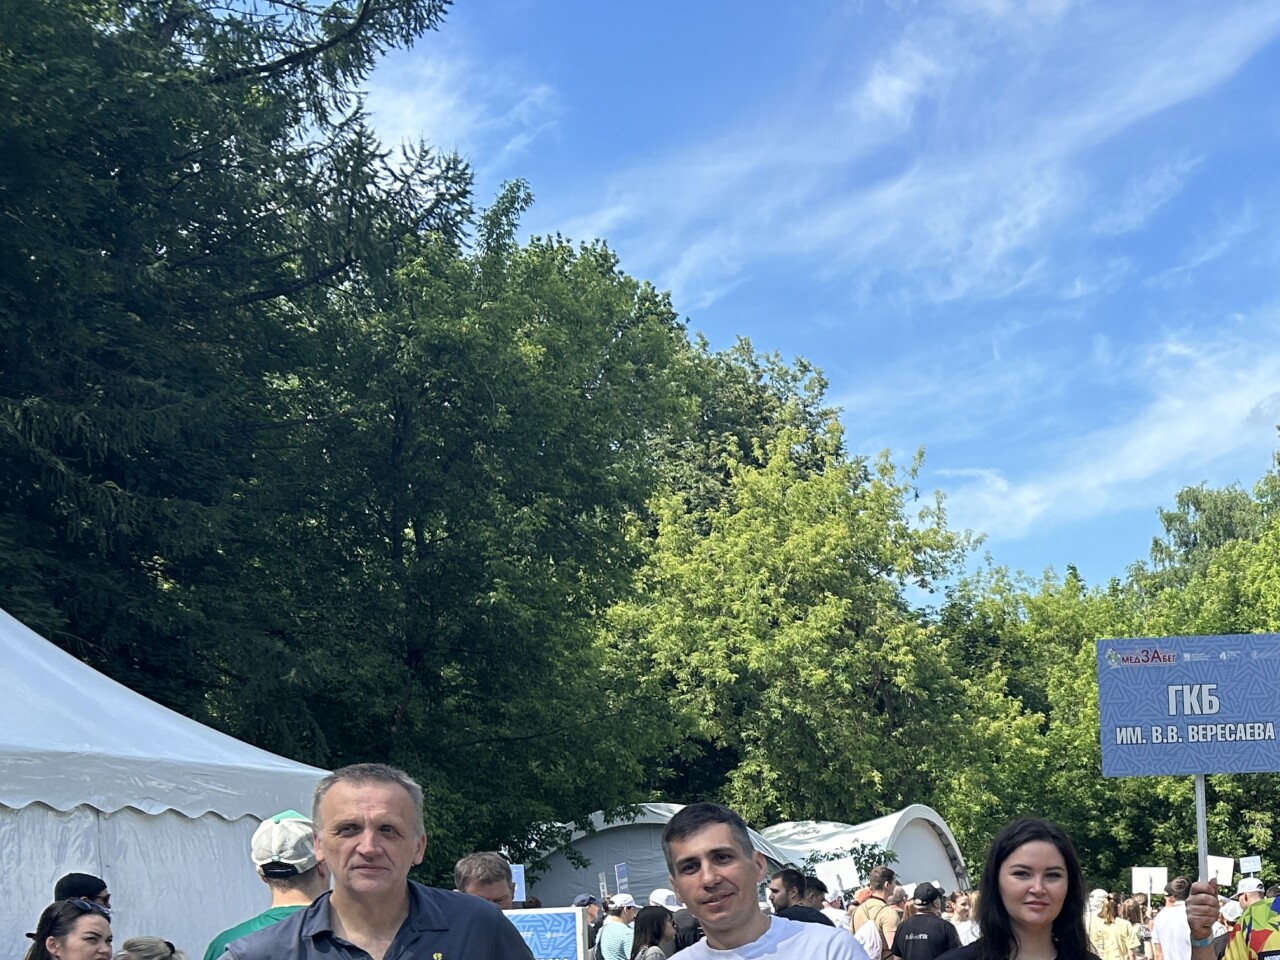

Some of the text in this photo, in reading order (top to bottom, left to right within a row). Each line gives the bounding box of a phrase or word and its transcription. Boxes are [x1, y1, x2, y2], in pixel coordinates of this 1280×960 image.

[1167, 683, 1220, 716] ГКБ
[1115, 722, 1276, 745] ИМ. В.В. ВЕРЕСАЕВА
